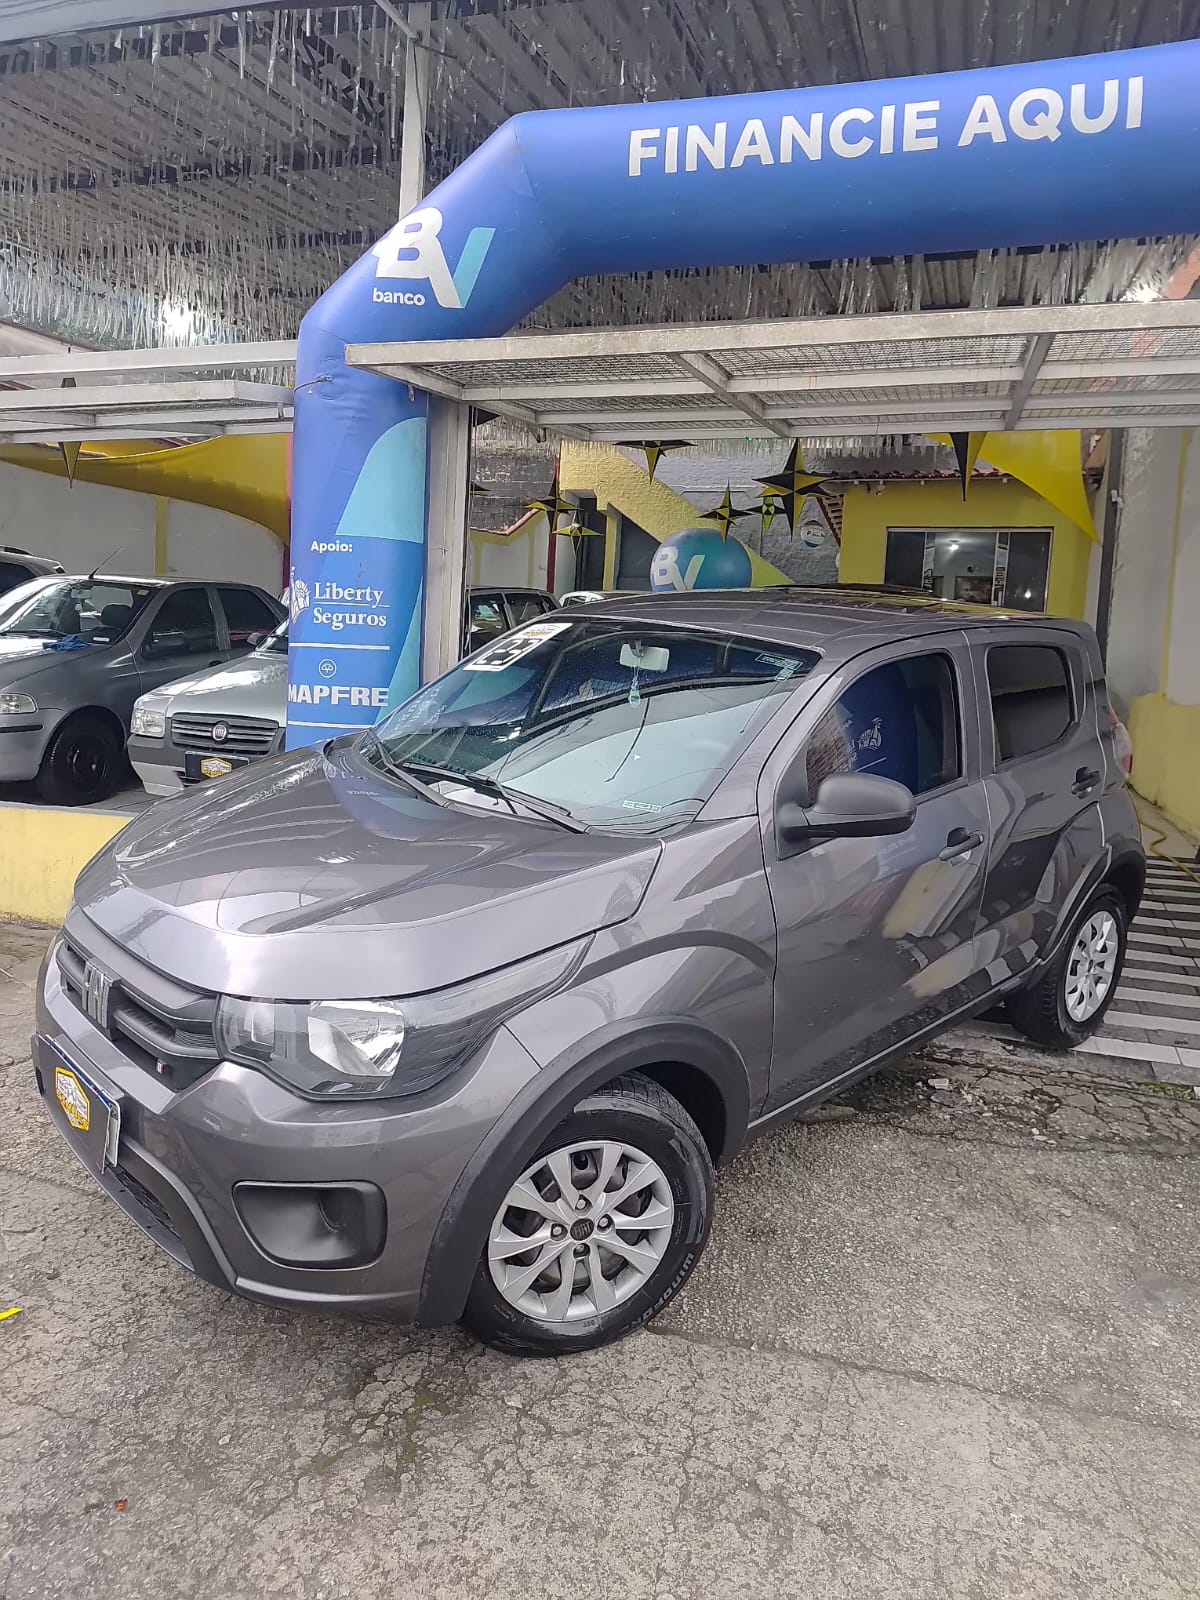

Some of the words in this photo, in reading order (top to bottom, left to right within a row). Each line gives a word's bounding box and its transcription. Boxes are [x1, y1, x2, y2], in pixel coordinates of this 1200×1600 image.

[628, 100, 941, 177] FINANCIE
[957, 76, 1144, 147] AQUI
[371, 207, 497, 309] BV
[372, 287, 426, 306] banco
[310, 540, 353, 553] Apoio:
[651, 546, 706, 591] BV
[314, 582, 384, 608] Liberty
[313, 607, 387, 631] Seguros
[288, 684, 390, 707] MAPFRE
[81, 961, 114, 1029] FIAT
